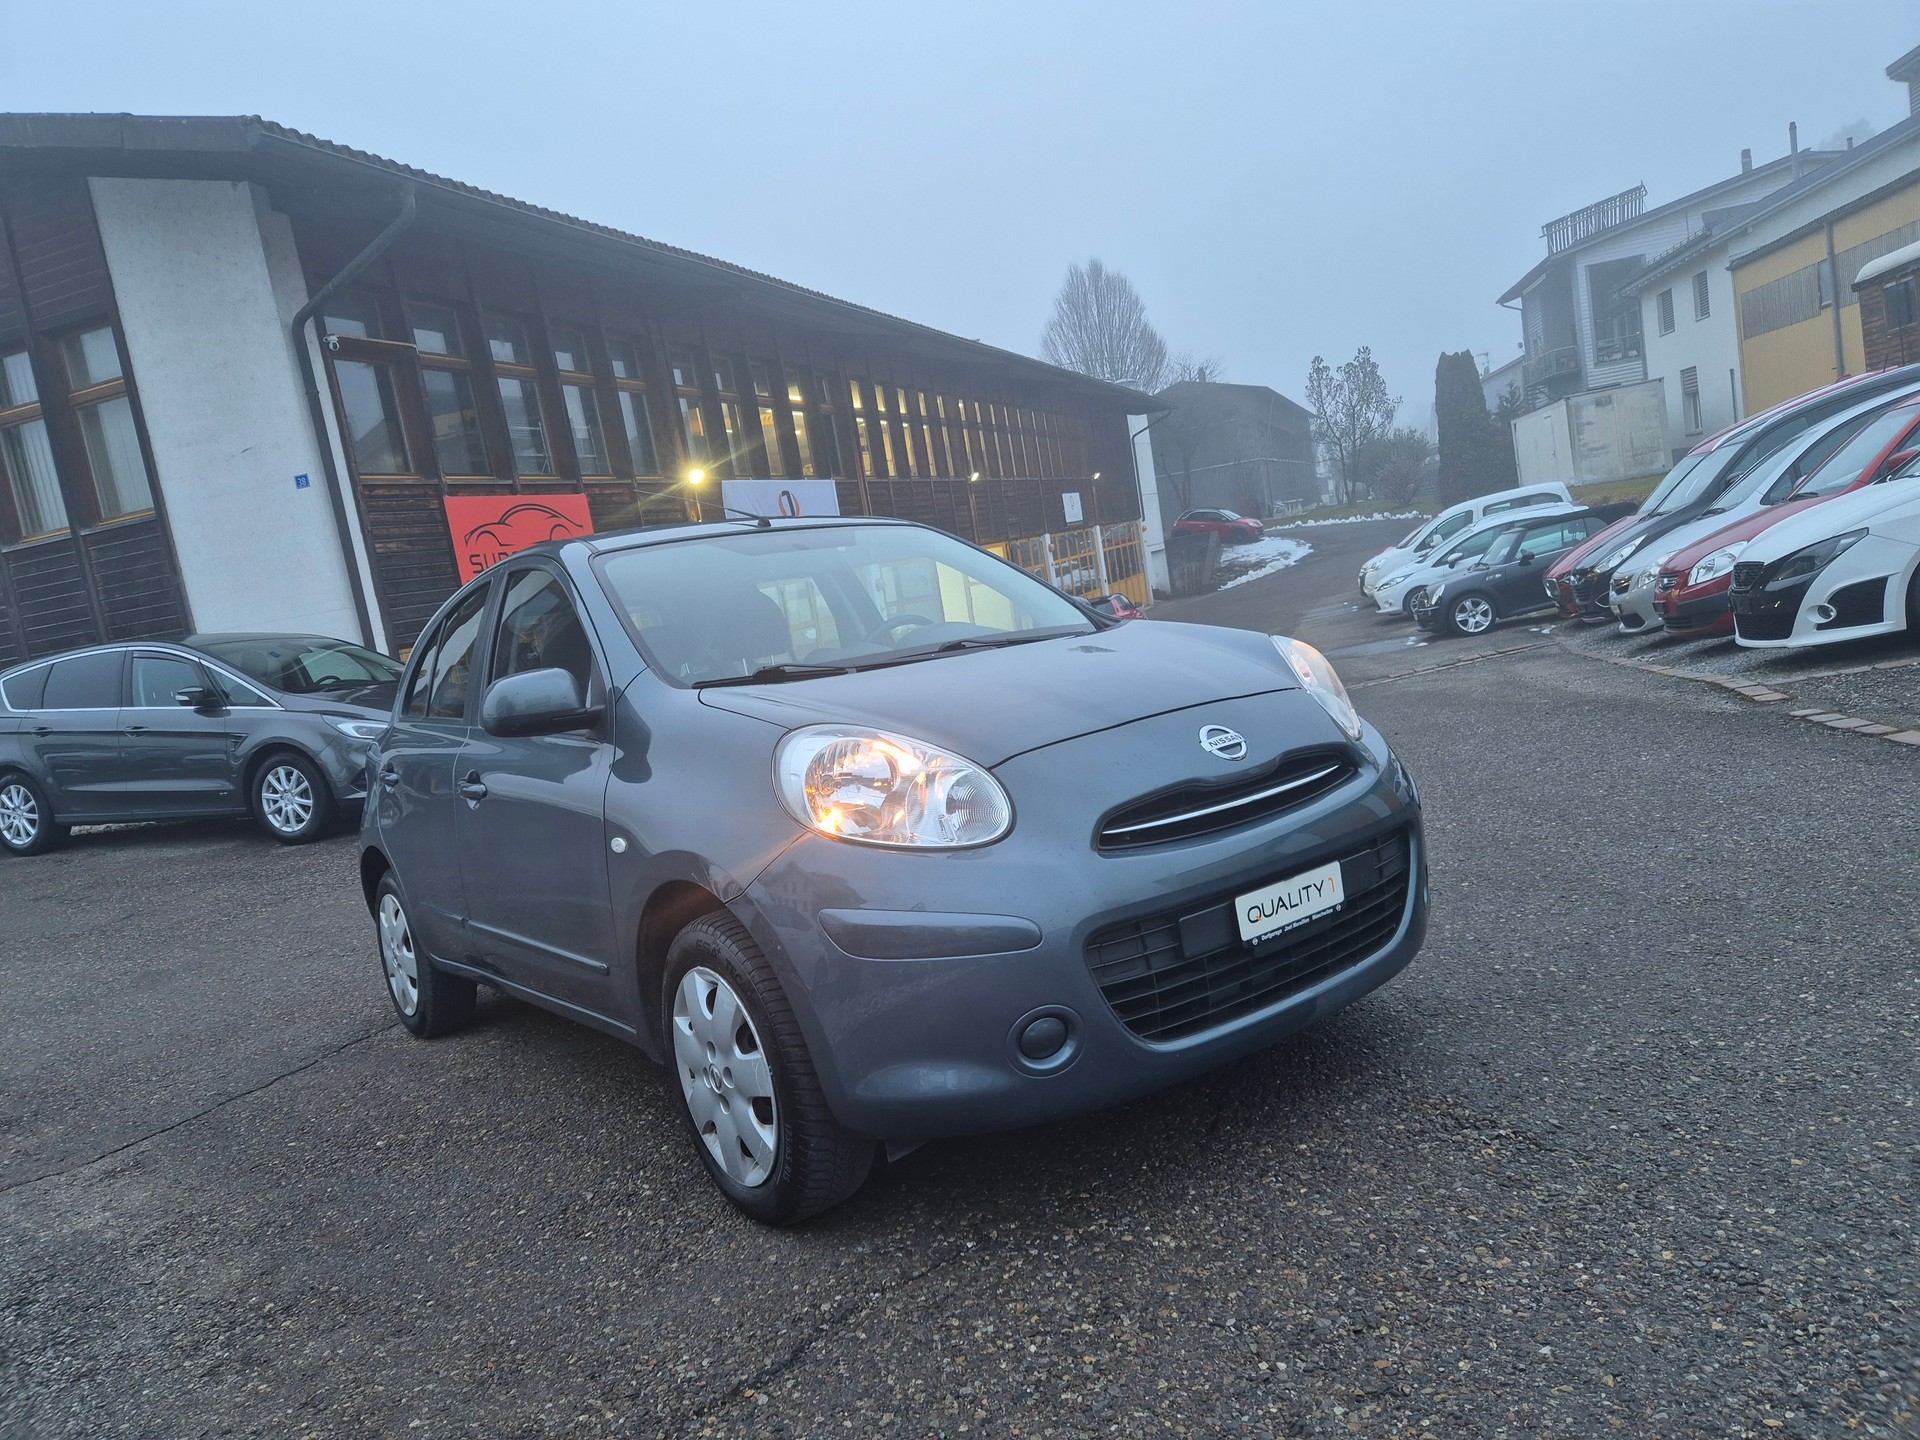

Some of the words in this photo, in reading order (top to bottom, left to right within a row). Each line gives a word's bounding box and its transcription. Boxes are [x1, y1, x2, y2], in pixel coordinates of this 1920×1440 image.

[297, 477, 306, 487] 38
[1208, 734, 1242, 748] NISSAN
[1247, 880, 1325, 924] QUALITY
[1328, 877, 1335, 892] 1
